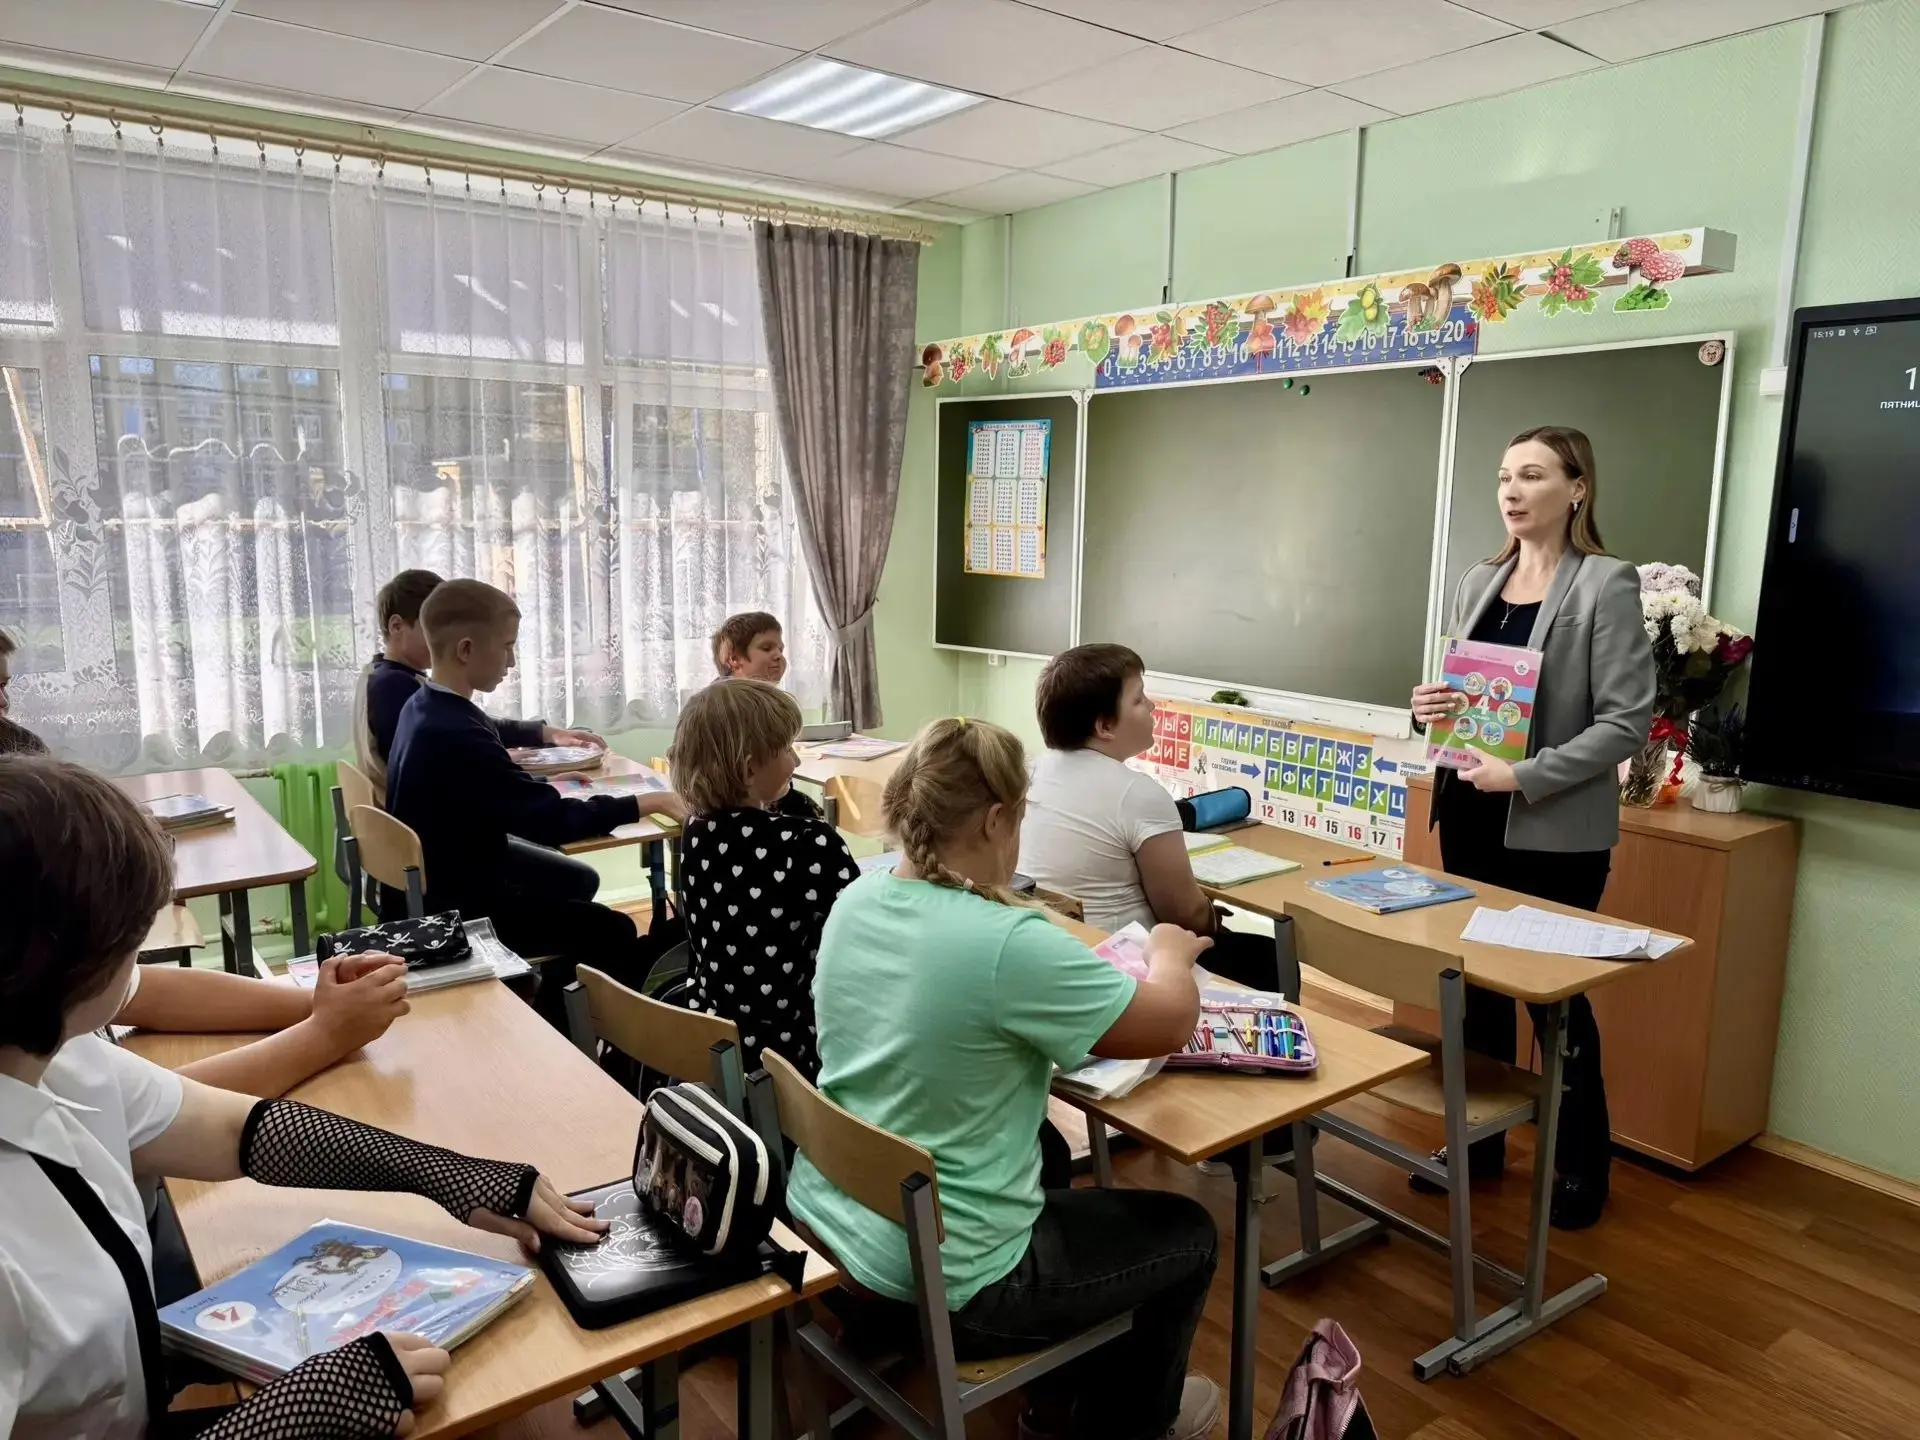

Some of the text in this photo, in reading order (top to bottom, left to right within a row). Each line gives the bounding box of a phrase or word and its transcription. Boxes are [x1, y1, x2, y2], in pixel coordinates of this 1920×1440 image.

[1104, 359, 1112, 377] 0
[1139, 355, 1147, 374] 3
[1177, 351, 1186, 370] 6
[1203, 348, 1212, 368] 8
[1218, 346, 1226, 366] 9
[1232, 342, 1248, 364] 10
[1272, 338, 1284, 359] 11
[1286, 336, 1300, 358] 12
[1304, 336, 1318, 356] 13
[1322, 334, 1337, 354] 14
[1361, 331, 1376, 350] 16
[1383, 327, 1398, 348] 17
[1442, 320, 1465, 344] 20
[1475, 695, 1490, 714] 4
[1164, 718, 1176, 732] Ы
[1180, 720, 1190, 734] Э
[1194, 719, 1203, 738] Й
[1208, 725, 1218, 741] Л
[1222, 728, 1233, 744] М
[1238, 731, 1248, 746] Н
[1254, 733, 1264, 748] Р
[1270, 737, 1280, 752] Б
[1286, 740, 1297, 756] В
[1304, 744, 1314, 758] Г
[1320, 746, 1333, 766] Д
[1337, 750, 1352, 766] Ж
[1357, 753, 1368, 770] З
[1164, 744, 1174, 760] И
[1178, 748, 1188, 762] Е
[1268, 766, 1404, 814] П Ф К Т Ш С Х Ц
[1261, 804, 1274, 818] 12
[1282, 808, 1295, 824] 13
[1304, 814, 1317, 829] 14
[1326, 820, 1338, 834] 15
[1348, 826, 1362, 840] 16
[1372, 831, 1386, 846] 17
[1396, 836, 1402, 850] 1
[203, 1306, 241, 1324] 4
